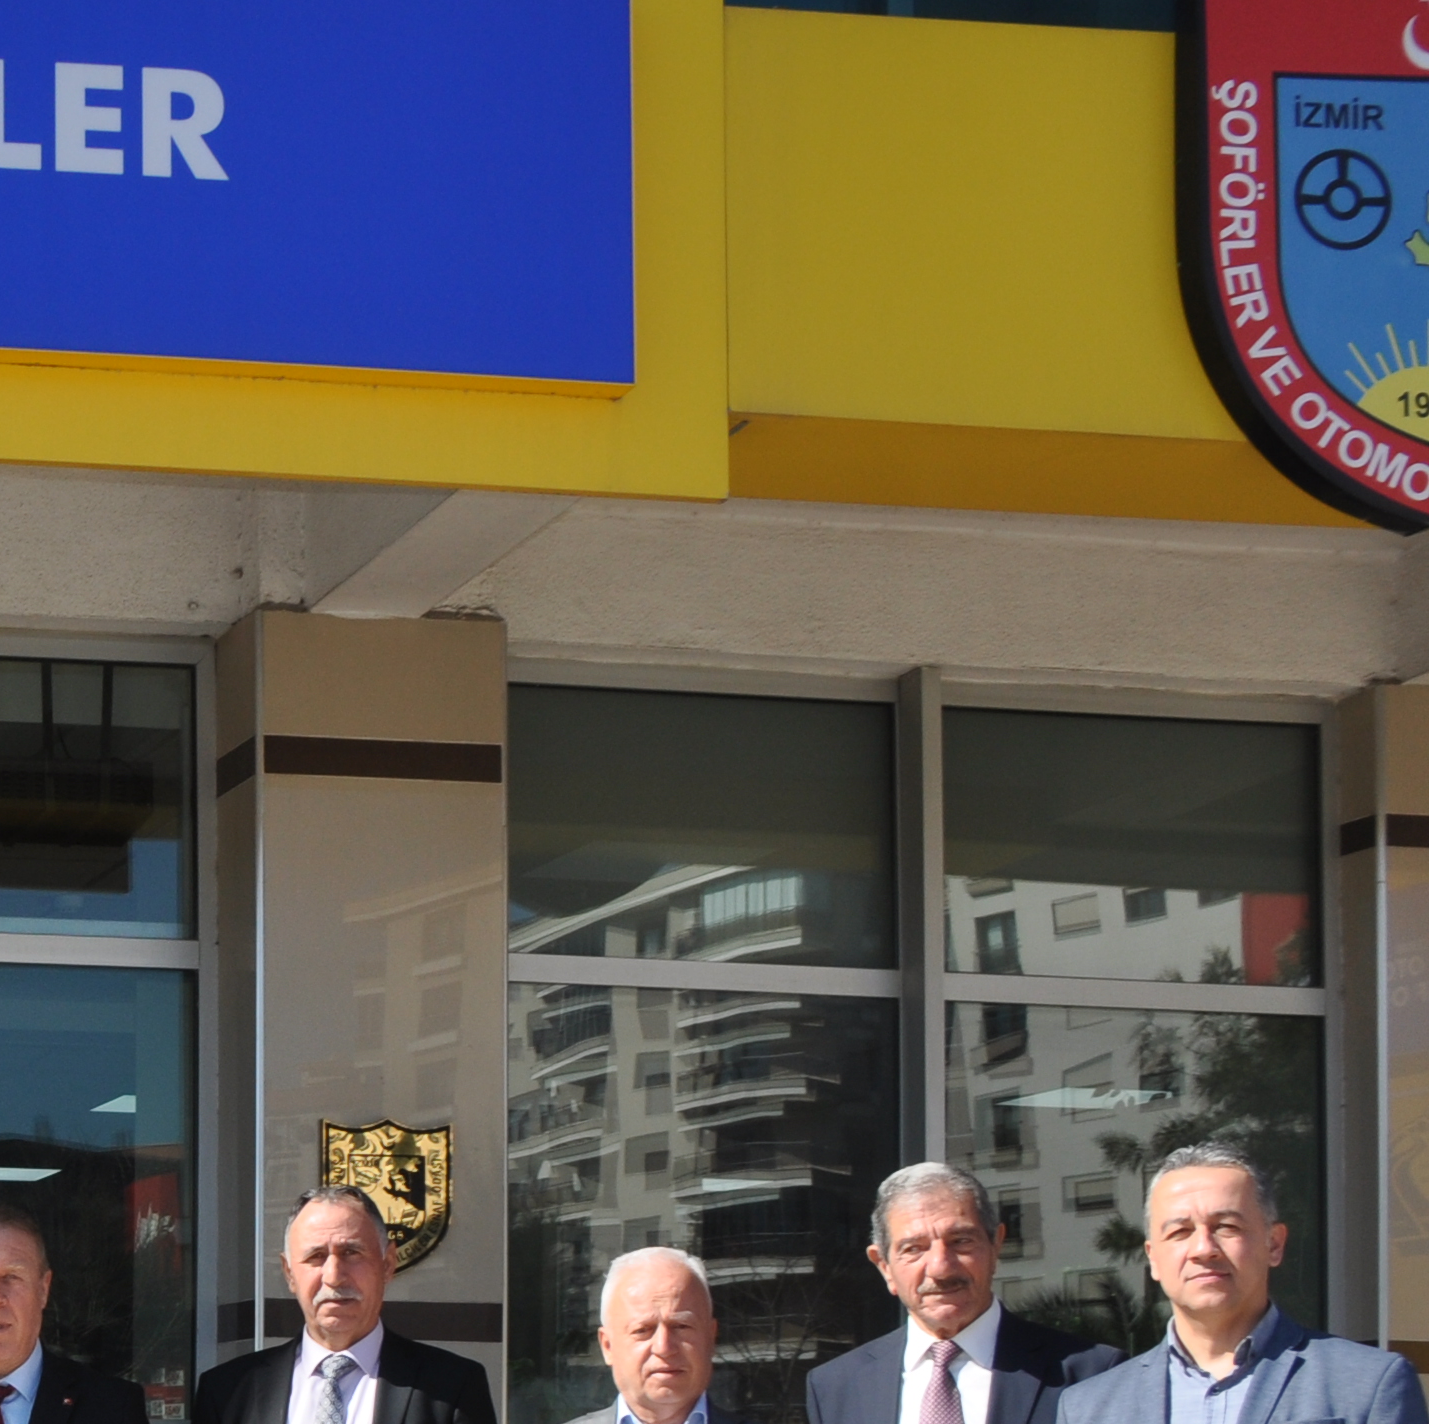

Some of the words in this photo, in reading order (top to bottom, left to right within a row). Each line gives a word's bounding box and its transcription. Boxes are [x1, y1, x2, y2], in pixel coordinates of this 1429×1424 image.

[1294, 94, 1385, 132] İZMİR
[1211, 78, 1270, 328] ŞOFÖRLER
[1248, 326, 1303, 396] VE
